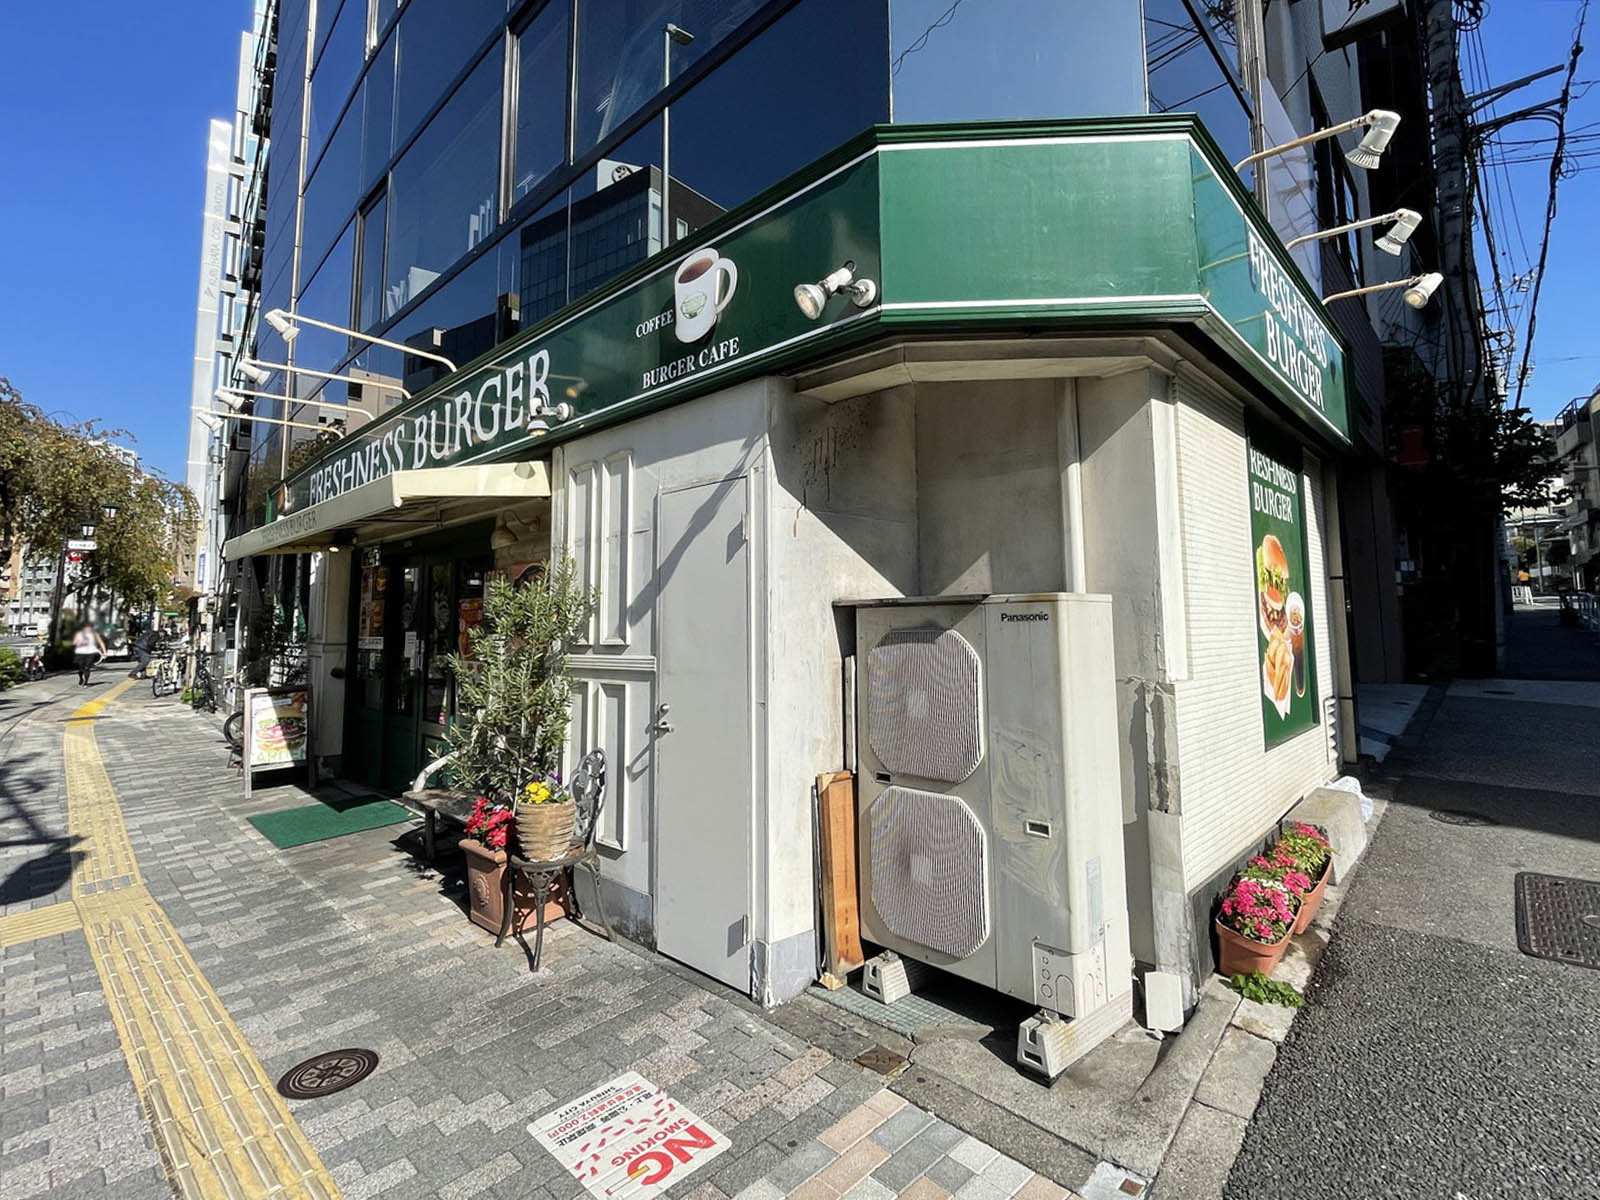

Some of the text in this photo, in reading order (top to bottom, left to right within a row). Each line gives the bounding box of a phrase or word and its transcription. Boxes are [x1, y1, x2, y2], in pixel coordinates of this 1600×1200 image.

[1249, 230, 1327, 369] FRESHNESS
[635, 309, 674, 338] COFFEE
[642, 337, 740, 389] BURGER CAFE
[1264, 310, 1325, 411] BURGER
[309, 349, 551, 506] FRESHNESS BURGER
[1253, 481, 1294, 524] BURGER
[1001, 611, 1049, 622] Panasonic
[558, 1105, 581, 1118] CITY
[581, 1085, 616, 1109] SHIBUYA
[611, 1117, 690, 1167] SMOKING
